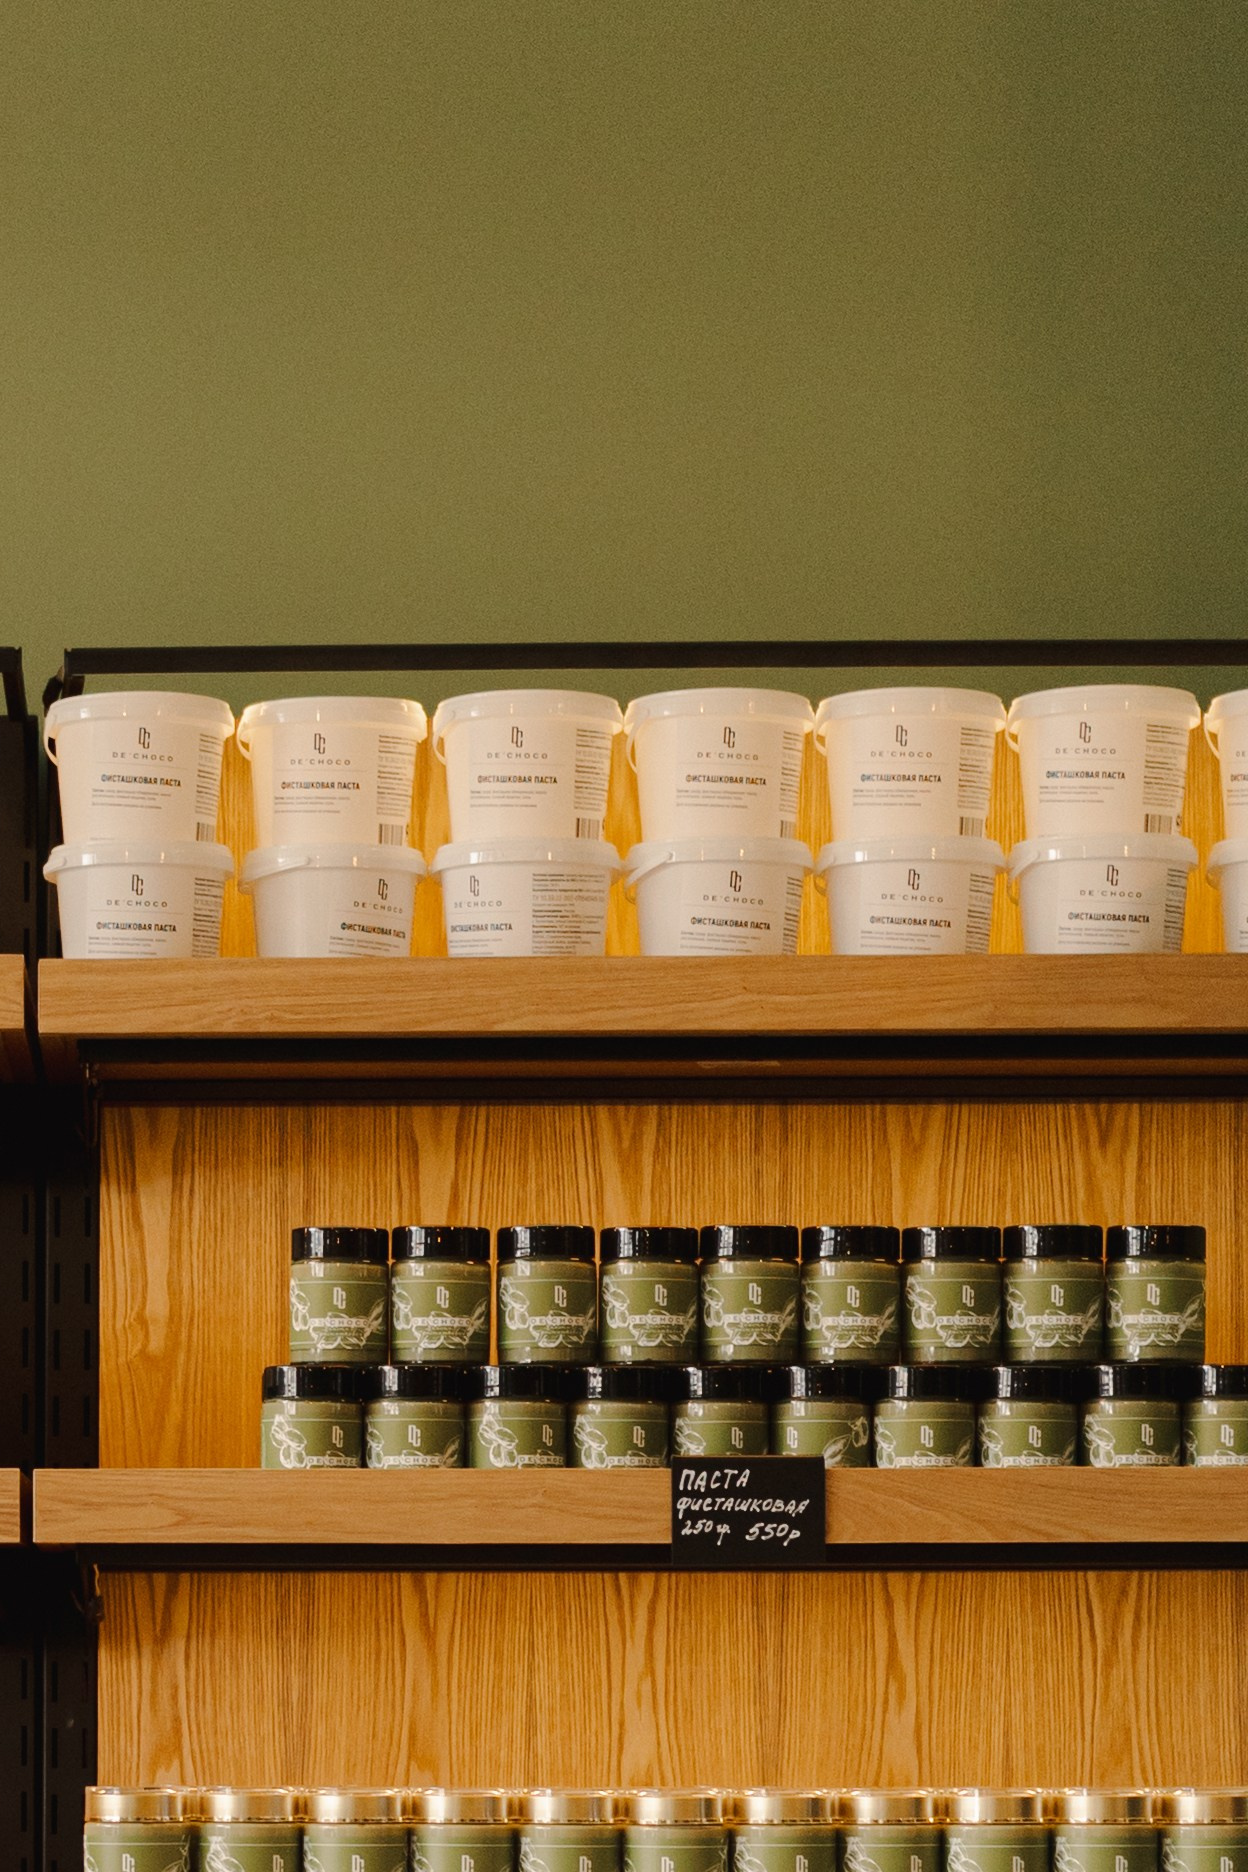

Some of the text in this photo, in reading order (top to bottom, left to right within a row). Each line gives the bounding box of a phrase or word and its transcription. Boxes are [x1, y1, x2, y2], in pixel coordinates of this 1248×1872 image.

[160, 778, 181, 787] ПАСТА
[534, 775, 557, 785] ПАСТА
[919, 774, 941, 783] ПАСТА
[929, 919, 951, 928] ПАСТА
[679, 1469, 750, 1492] ПАСТА
[677, 1497, 809, 1519] ФИСТАШКОВАЯ
